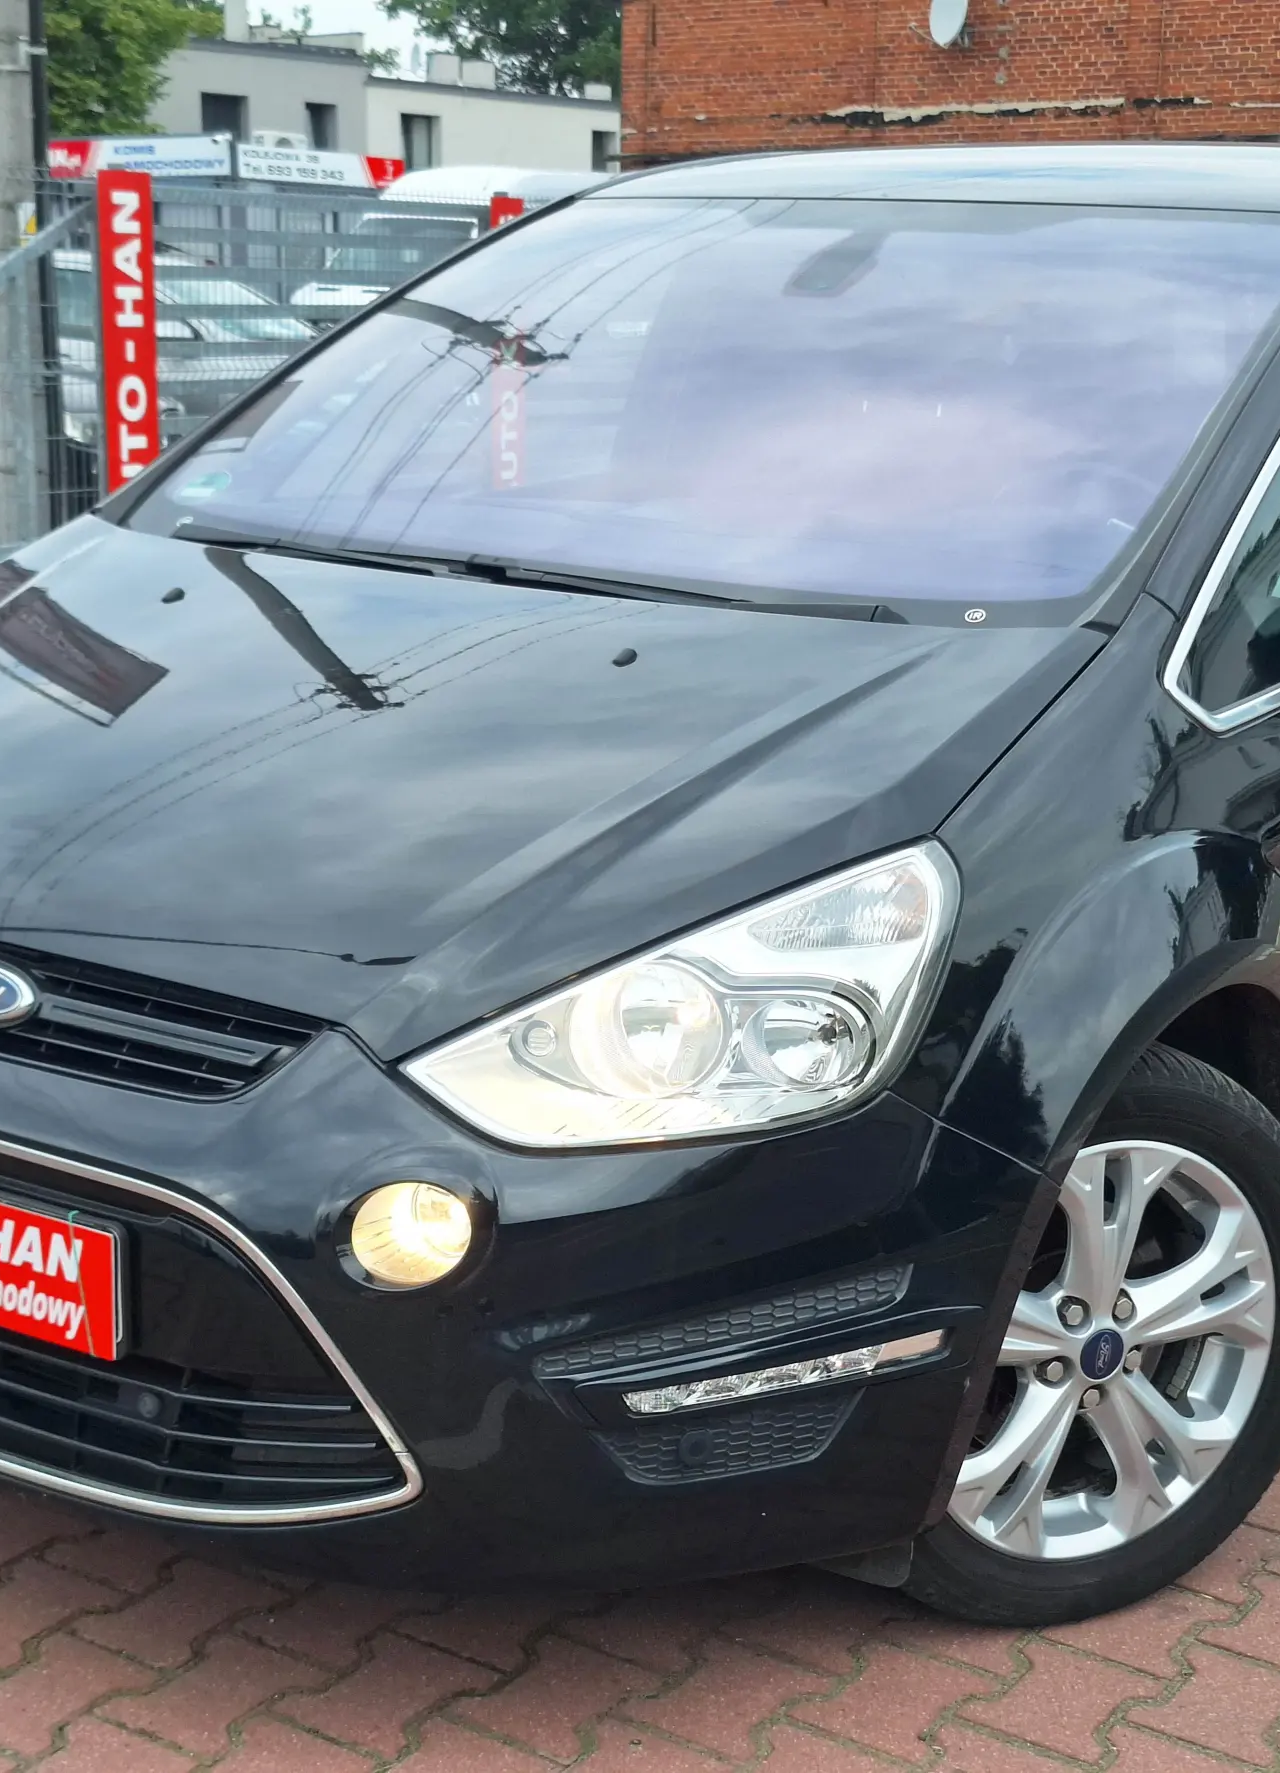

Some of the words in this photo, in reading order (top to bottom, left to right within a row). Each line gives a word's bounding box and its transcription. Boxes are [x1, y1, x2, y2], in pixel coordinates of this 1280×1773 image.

[113, 145, 156, 155] KOMIS
[122, 159, 225, 171] AMOCHODOWY
[110, 189, 145, 328] HAN
